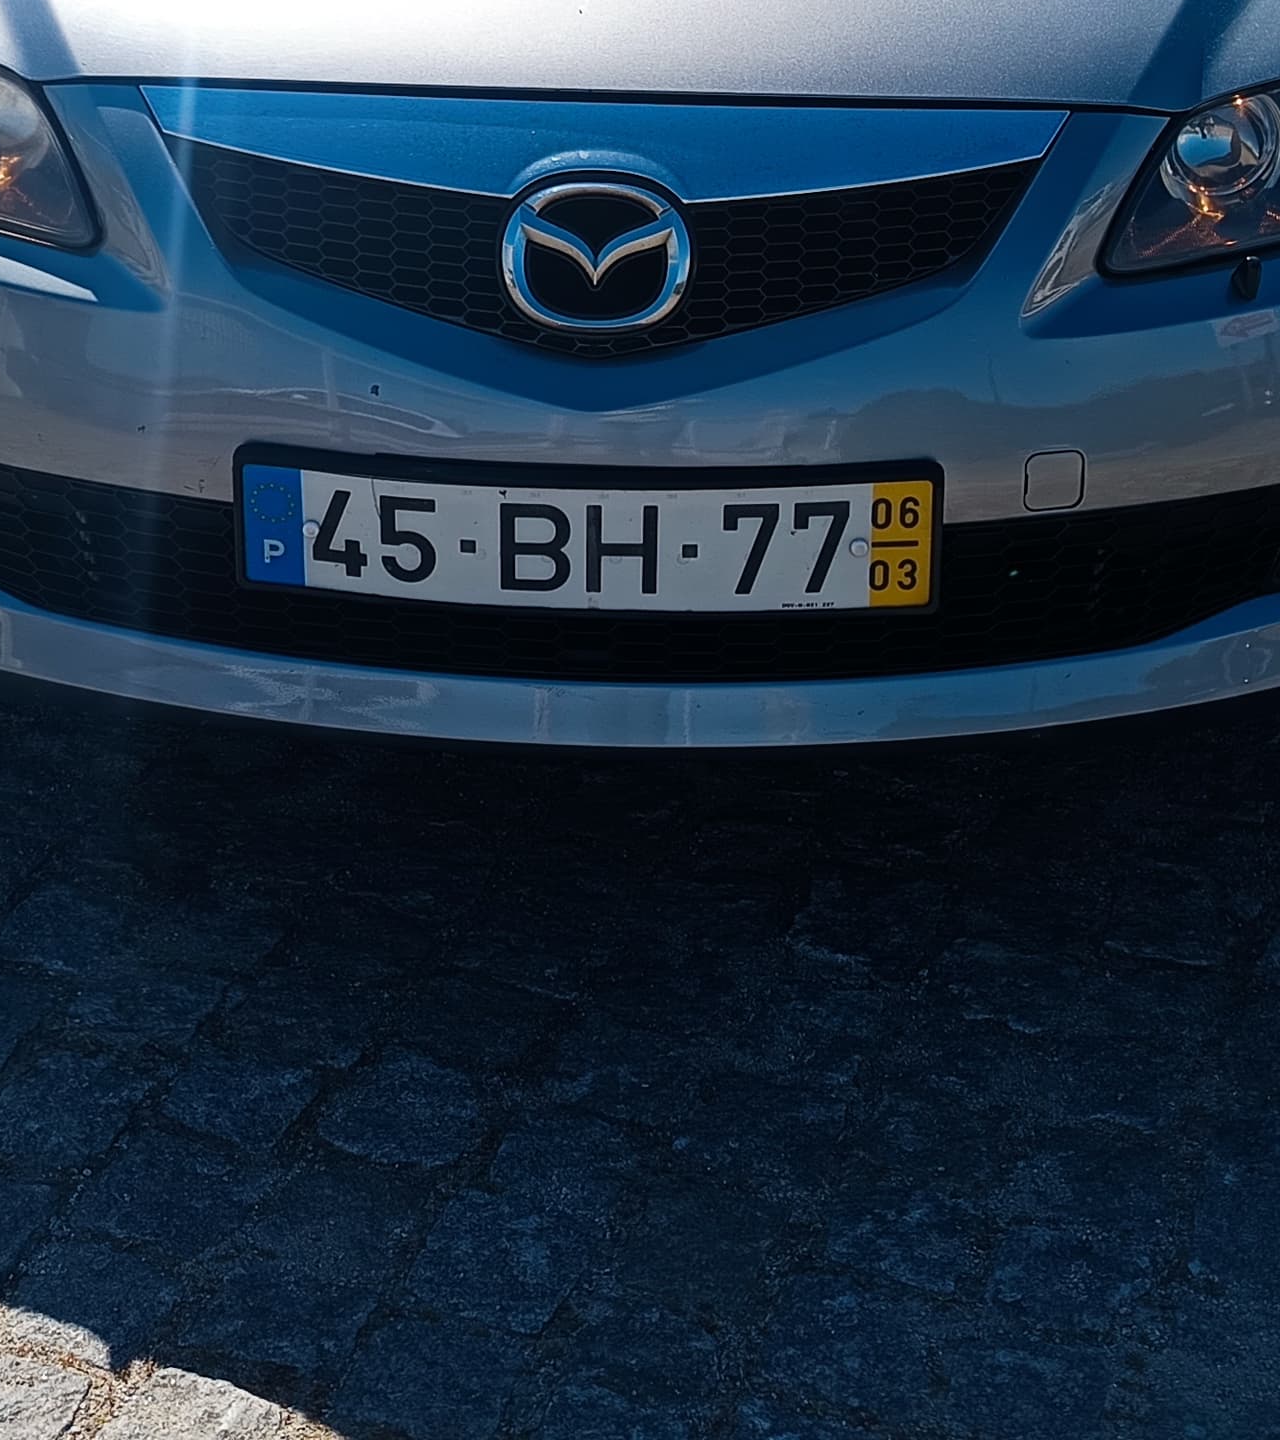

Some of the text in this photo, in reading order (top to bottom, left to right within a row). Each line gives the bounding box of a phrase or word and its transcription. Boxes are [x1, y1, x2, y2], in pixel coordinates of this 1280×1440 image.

[871, 496, 920, 530] 06
[263, 539, 285, 564] P
[869, 558, 918, 591] 03
